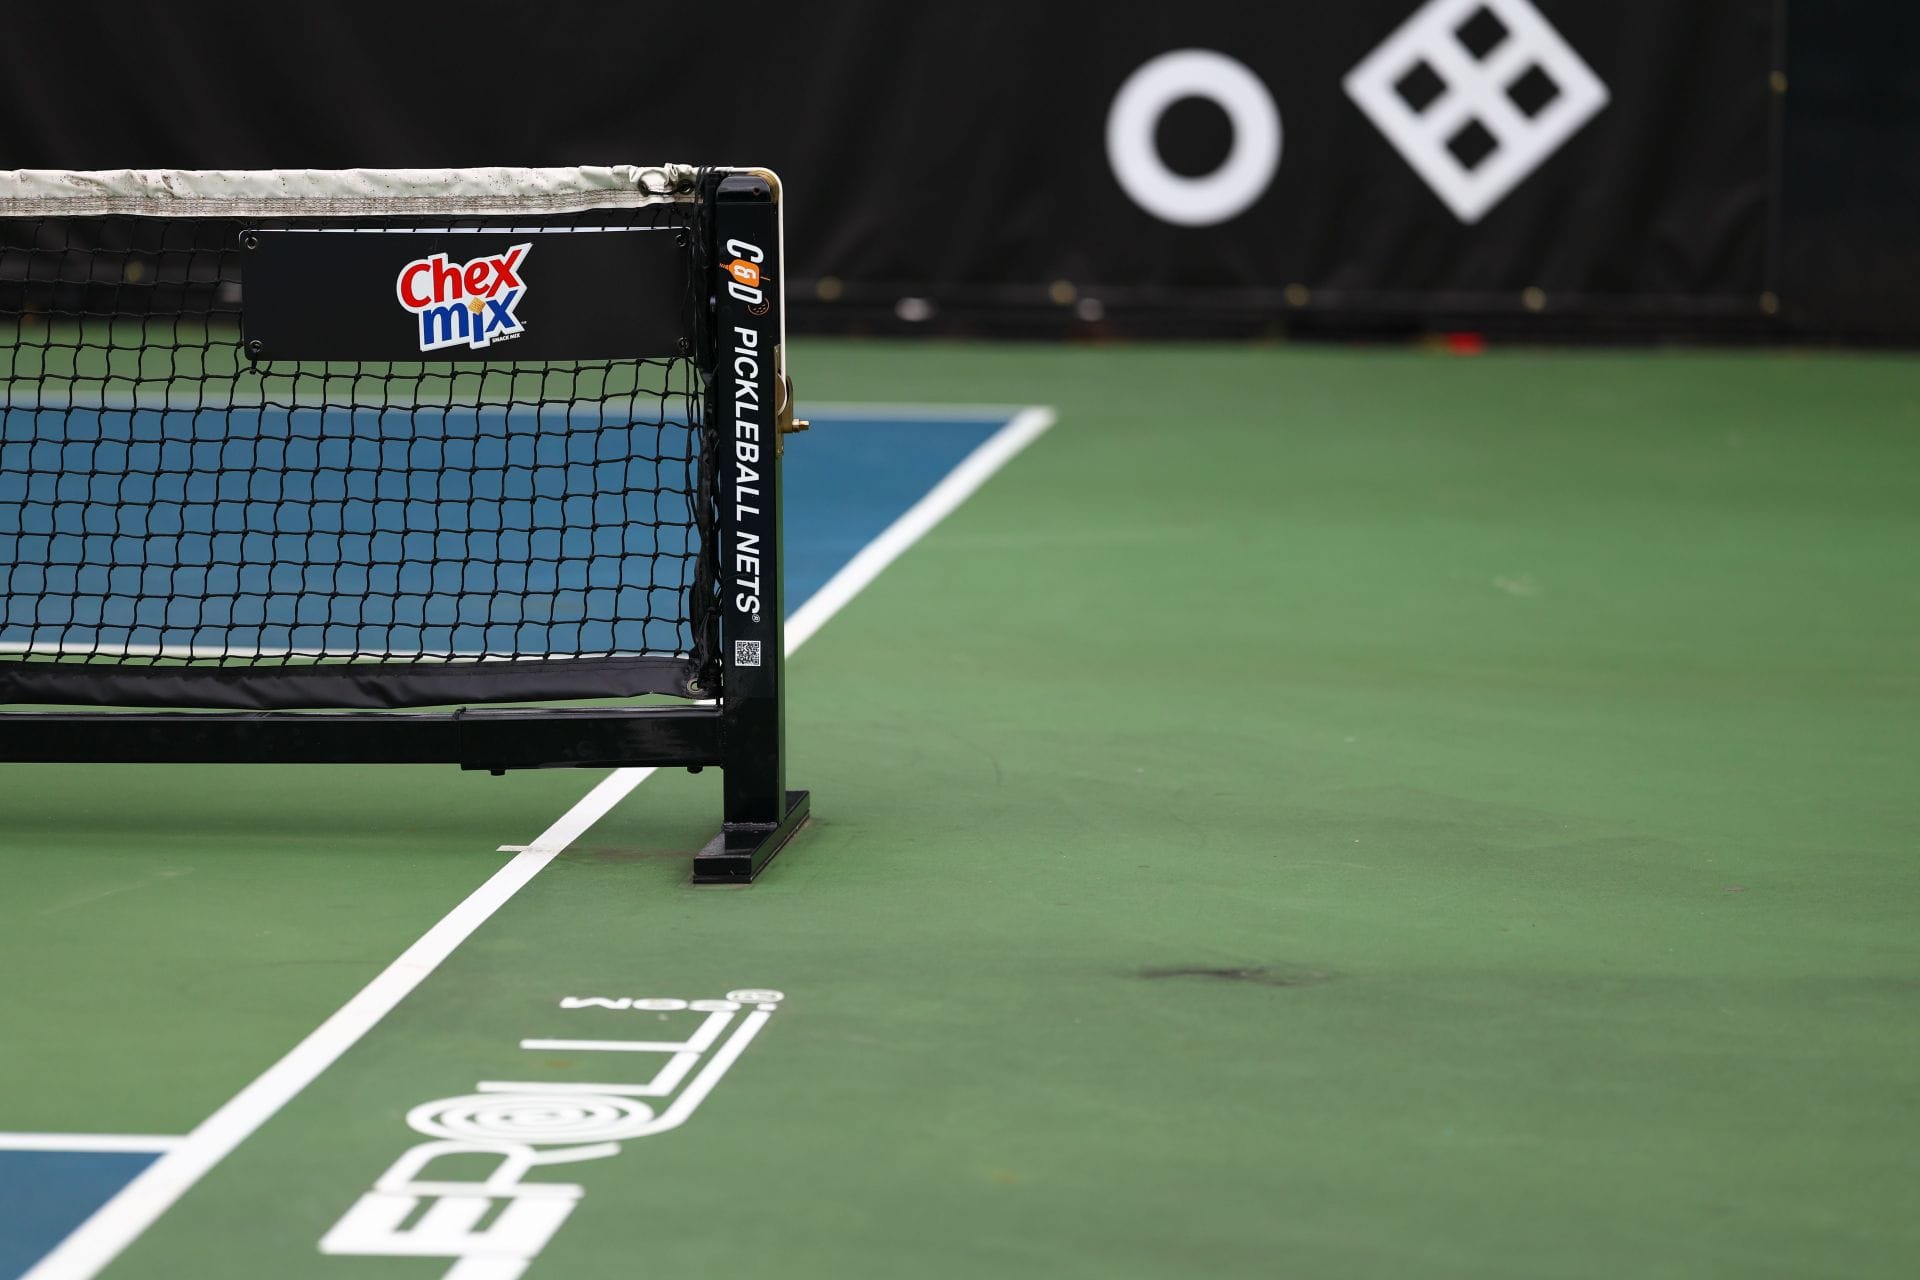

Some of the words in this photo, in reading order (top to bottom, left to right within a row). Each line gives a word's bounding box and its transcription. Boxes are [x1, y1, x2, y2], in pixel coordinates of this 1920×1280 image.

[401, 249, 522, 308] Chex
[727, 239, 764, 304] C&D
[423, 290, 518, 345] mix
[734, 326, 759, 521] PICKLEBALL
